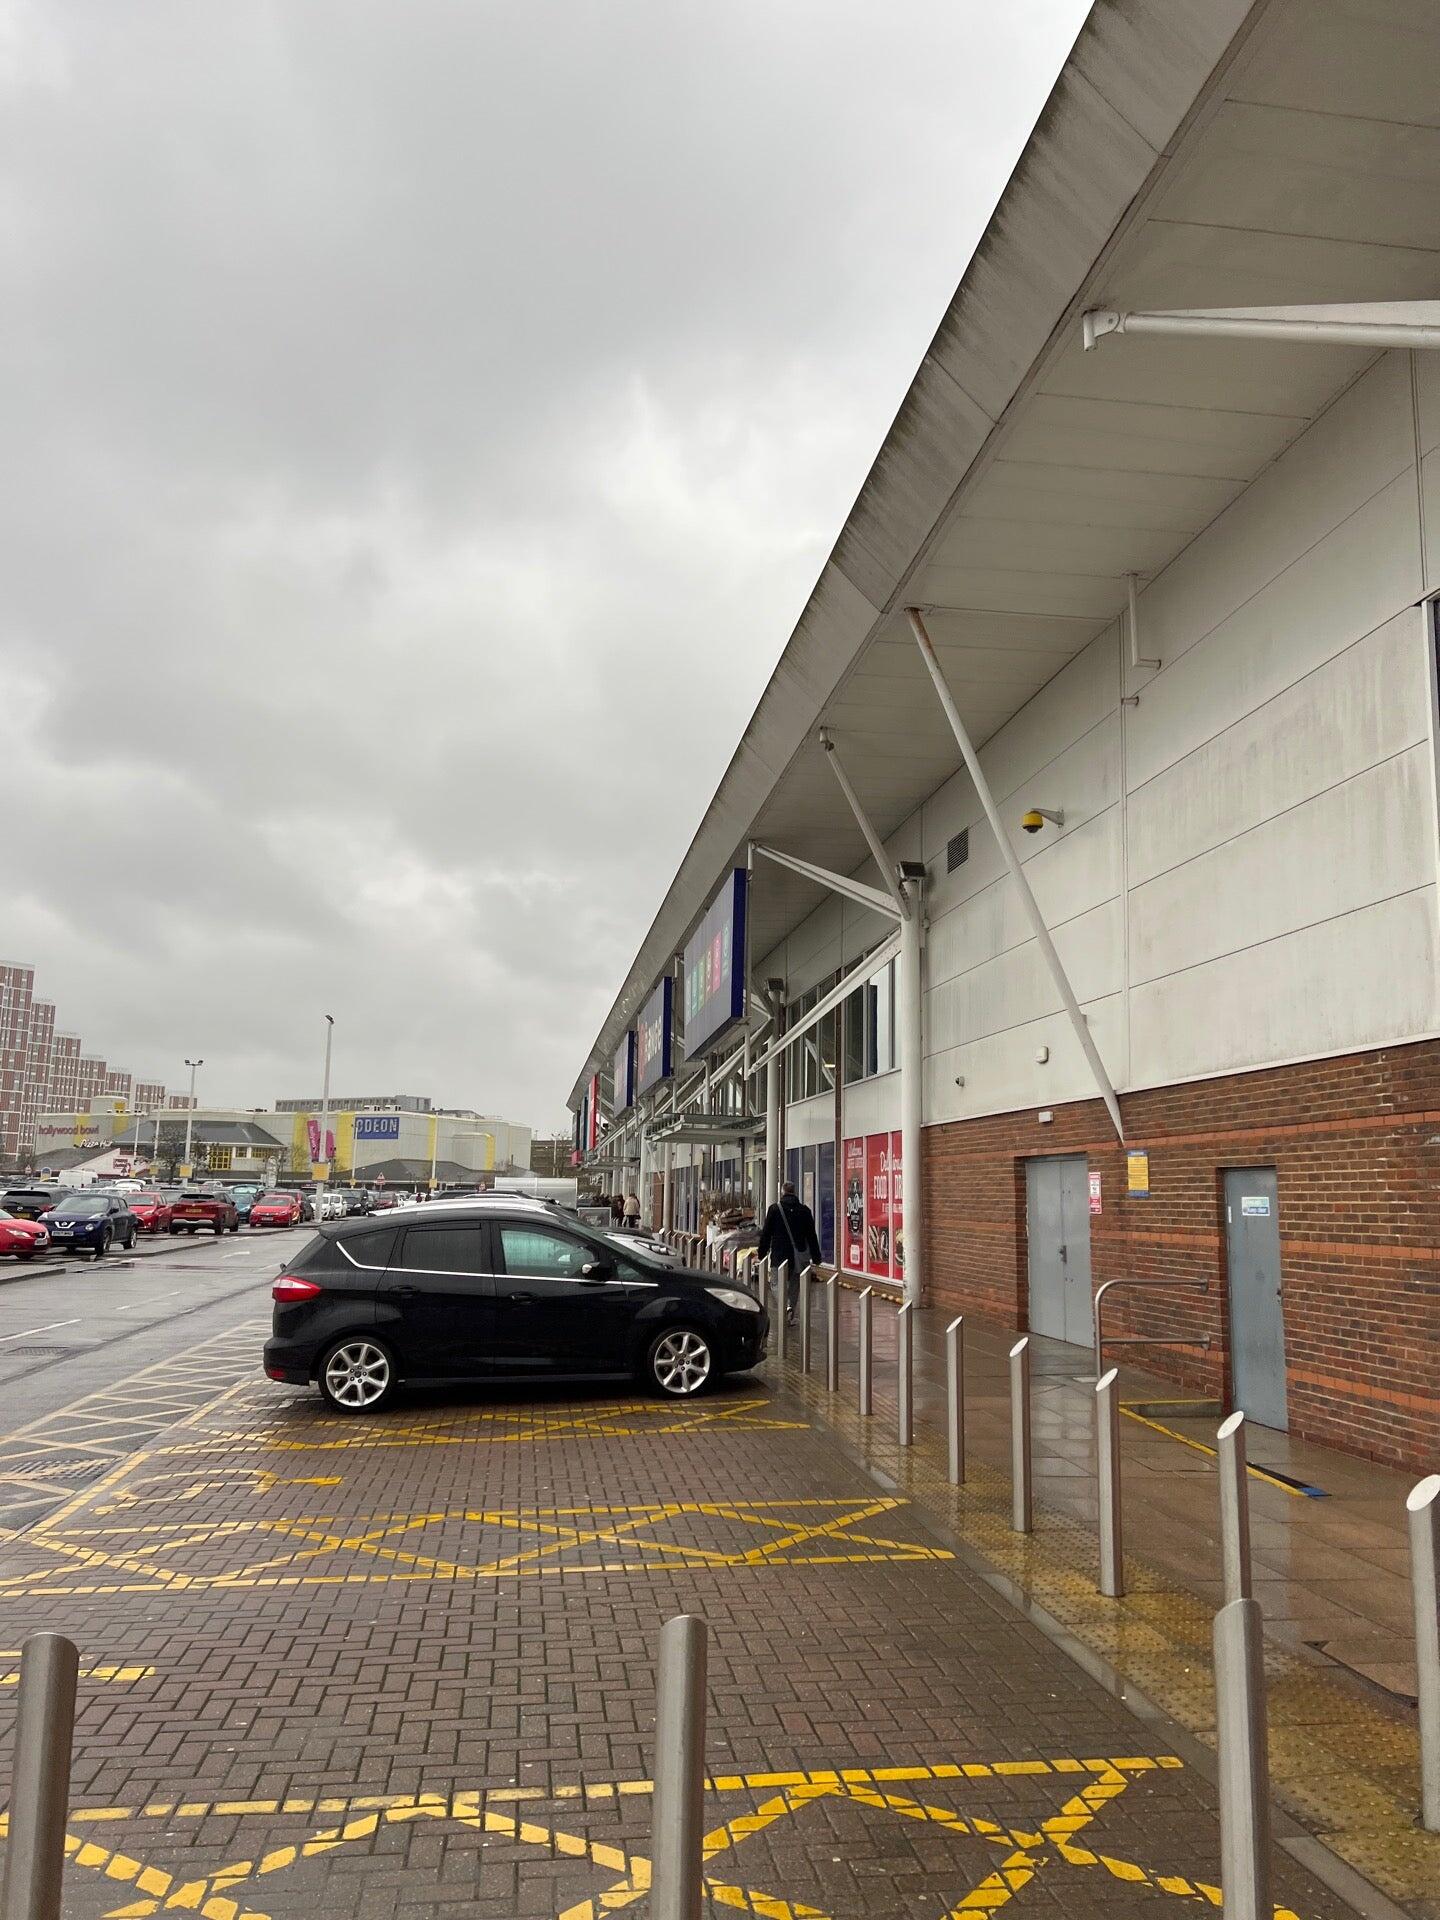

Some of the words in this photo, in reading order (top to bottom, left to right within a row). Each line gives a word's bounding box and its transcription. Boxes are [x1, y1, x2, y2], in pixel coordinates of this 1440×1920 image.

[38, 1124, 79, 1137] hollywood
[80, 1124, 99, 1135] bowl
[356, 1119, 398, 1133] ODEON
[80, 1139, 98, 1148] Pizza
[873, 1175, 887, 1199] FOOD
